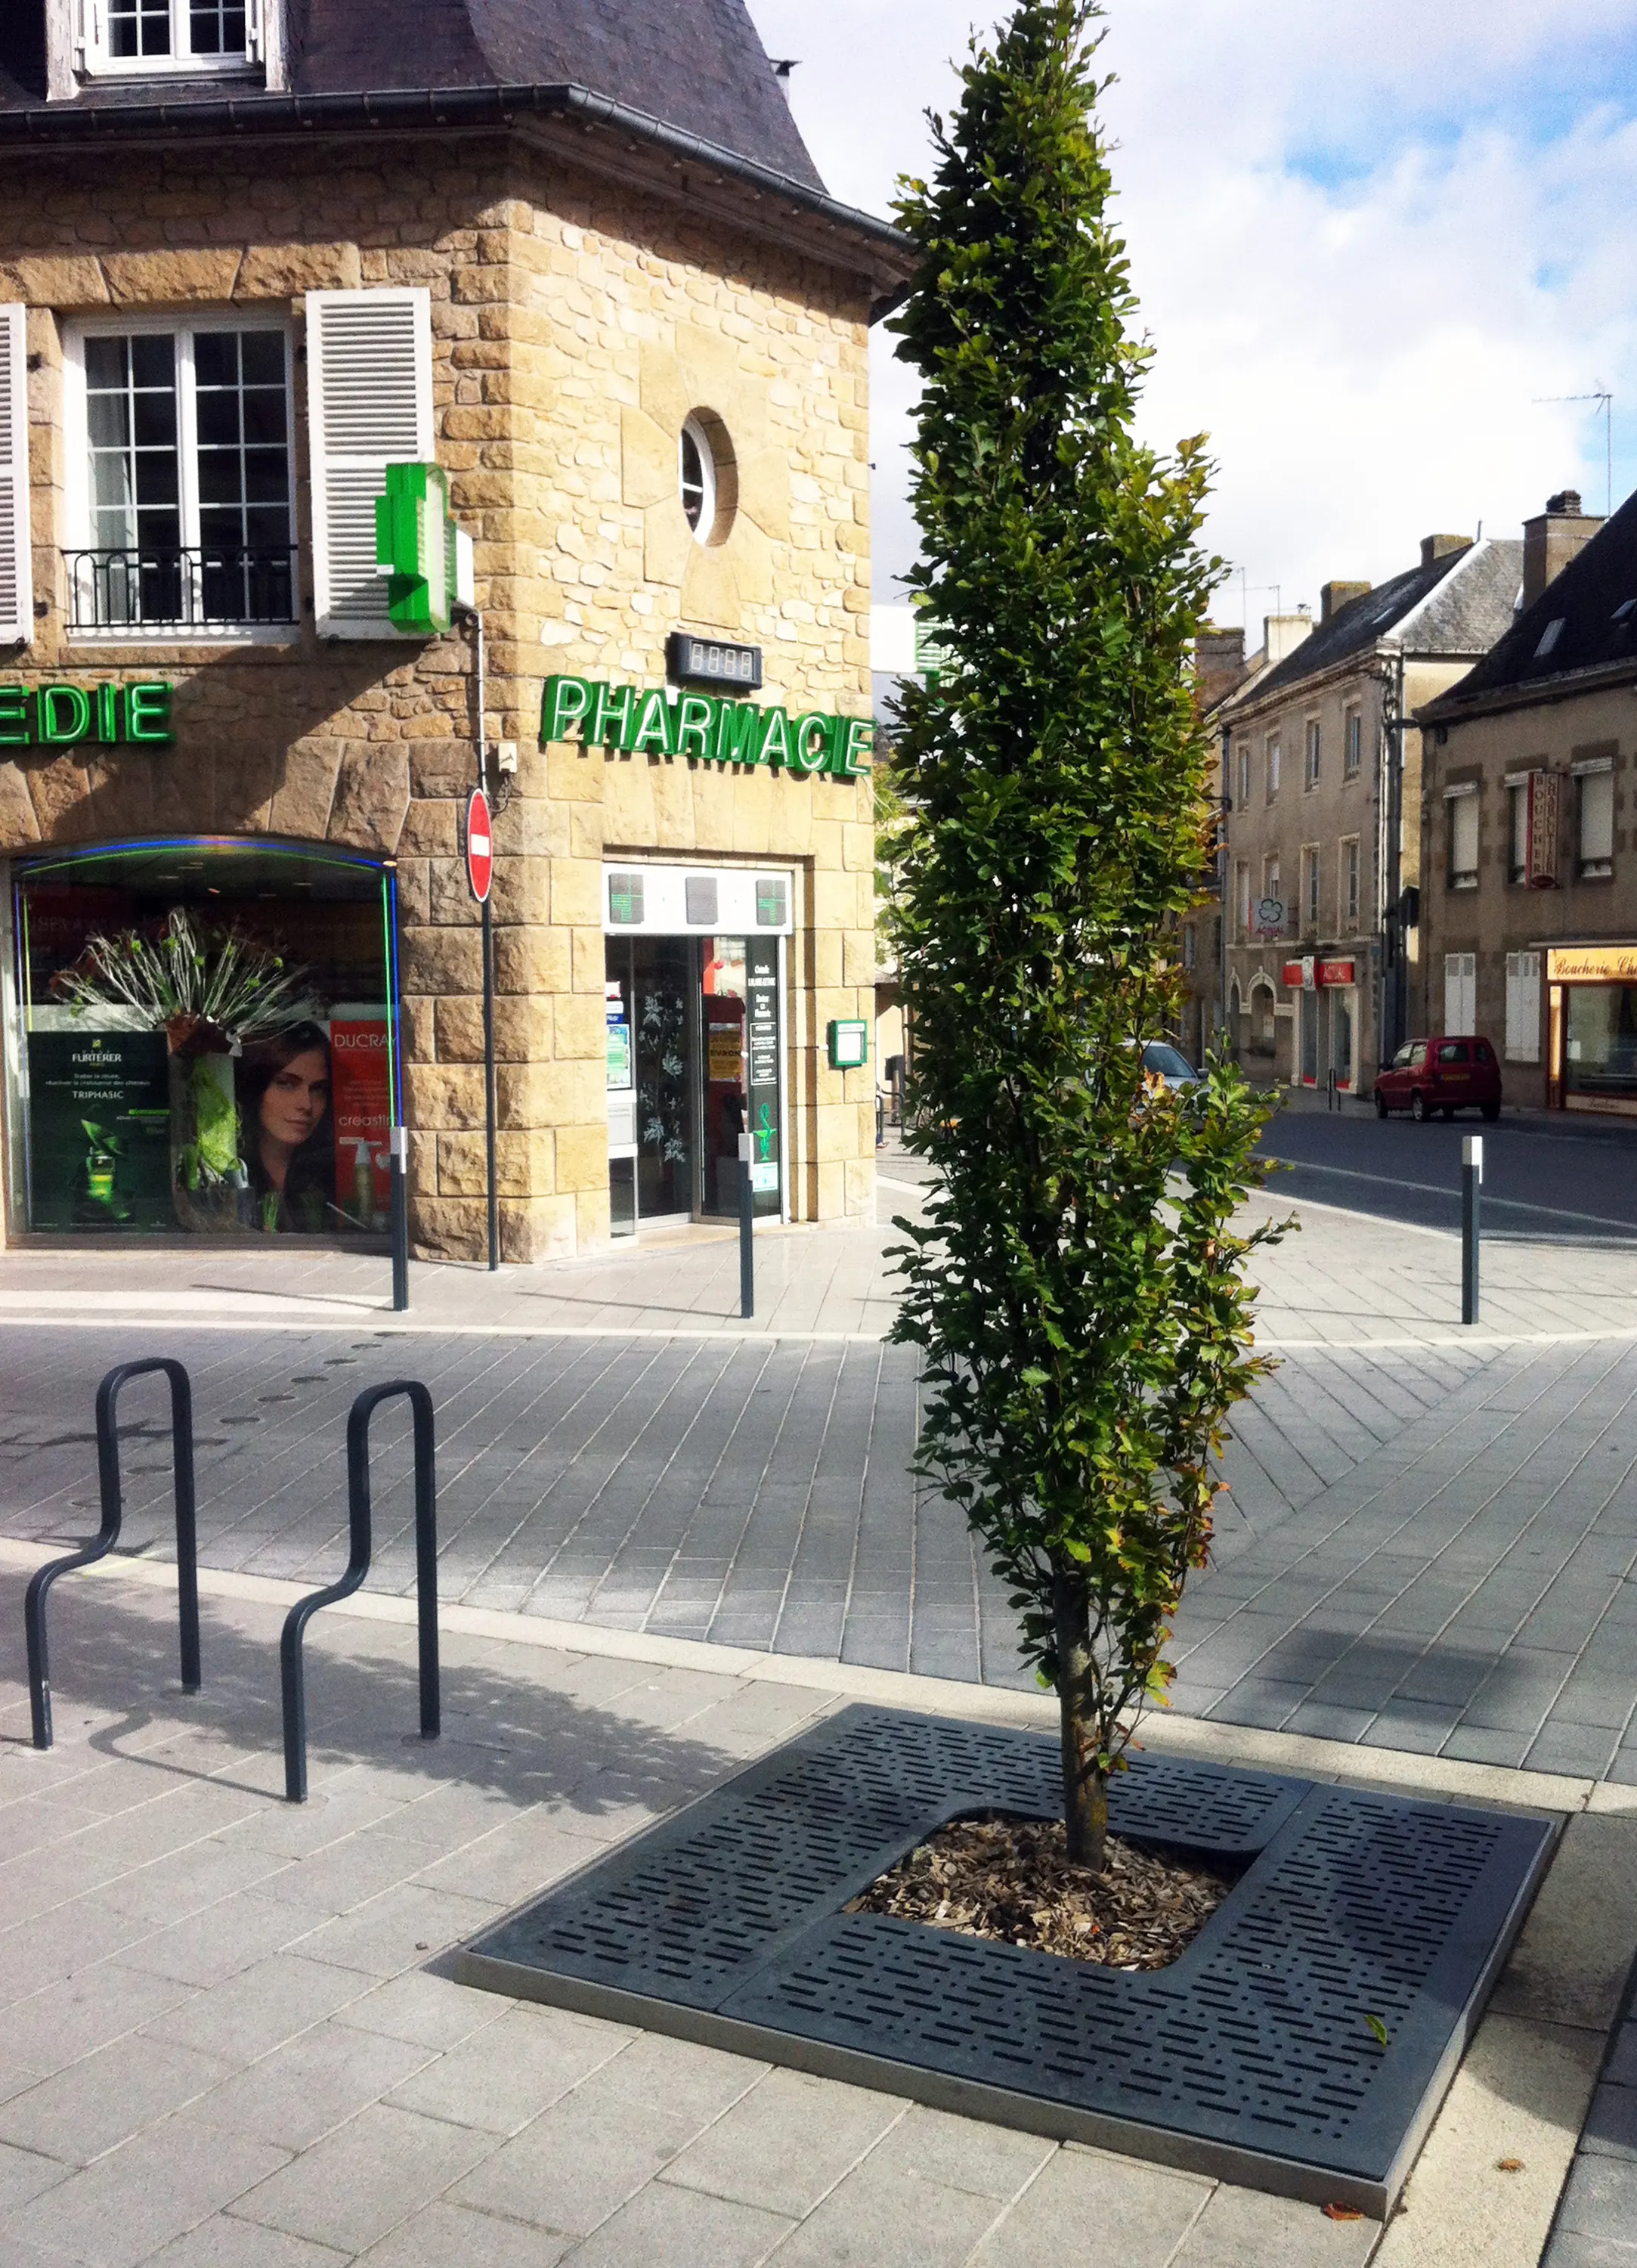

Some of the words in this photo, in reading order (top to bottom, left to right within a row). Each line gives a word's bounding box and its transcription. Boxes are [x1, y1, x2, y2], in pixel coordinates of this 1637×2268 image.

[545, 674, 877, 776] PHARMACIE
[1533, 775, 1544, 873] BOUCHER
[1555, 956, 1611, 976] Boucherie
[72, 1052, 122, 1062] FURTERER
[73, 1091, 124, 1099] TRIPHASIC
